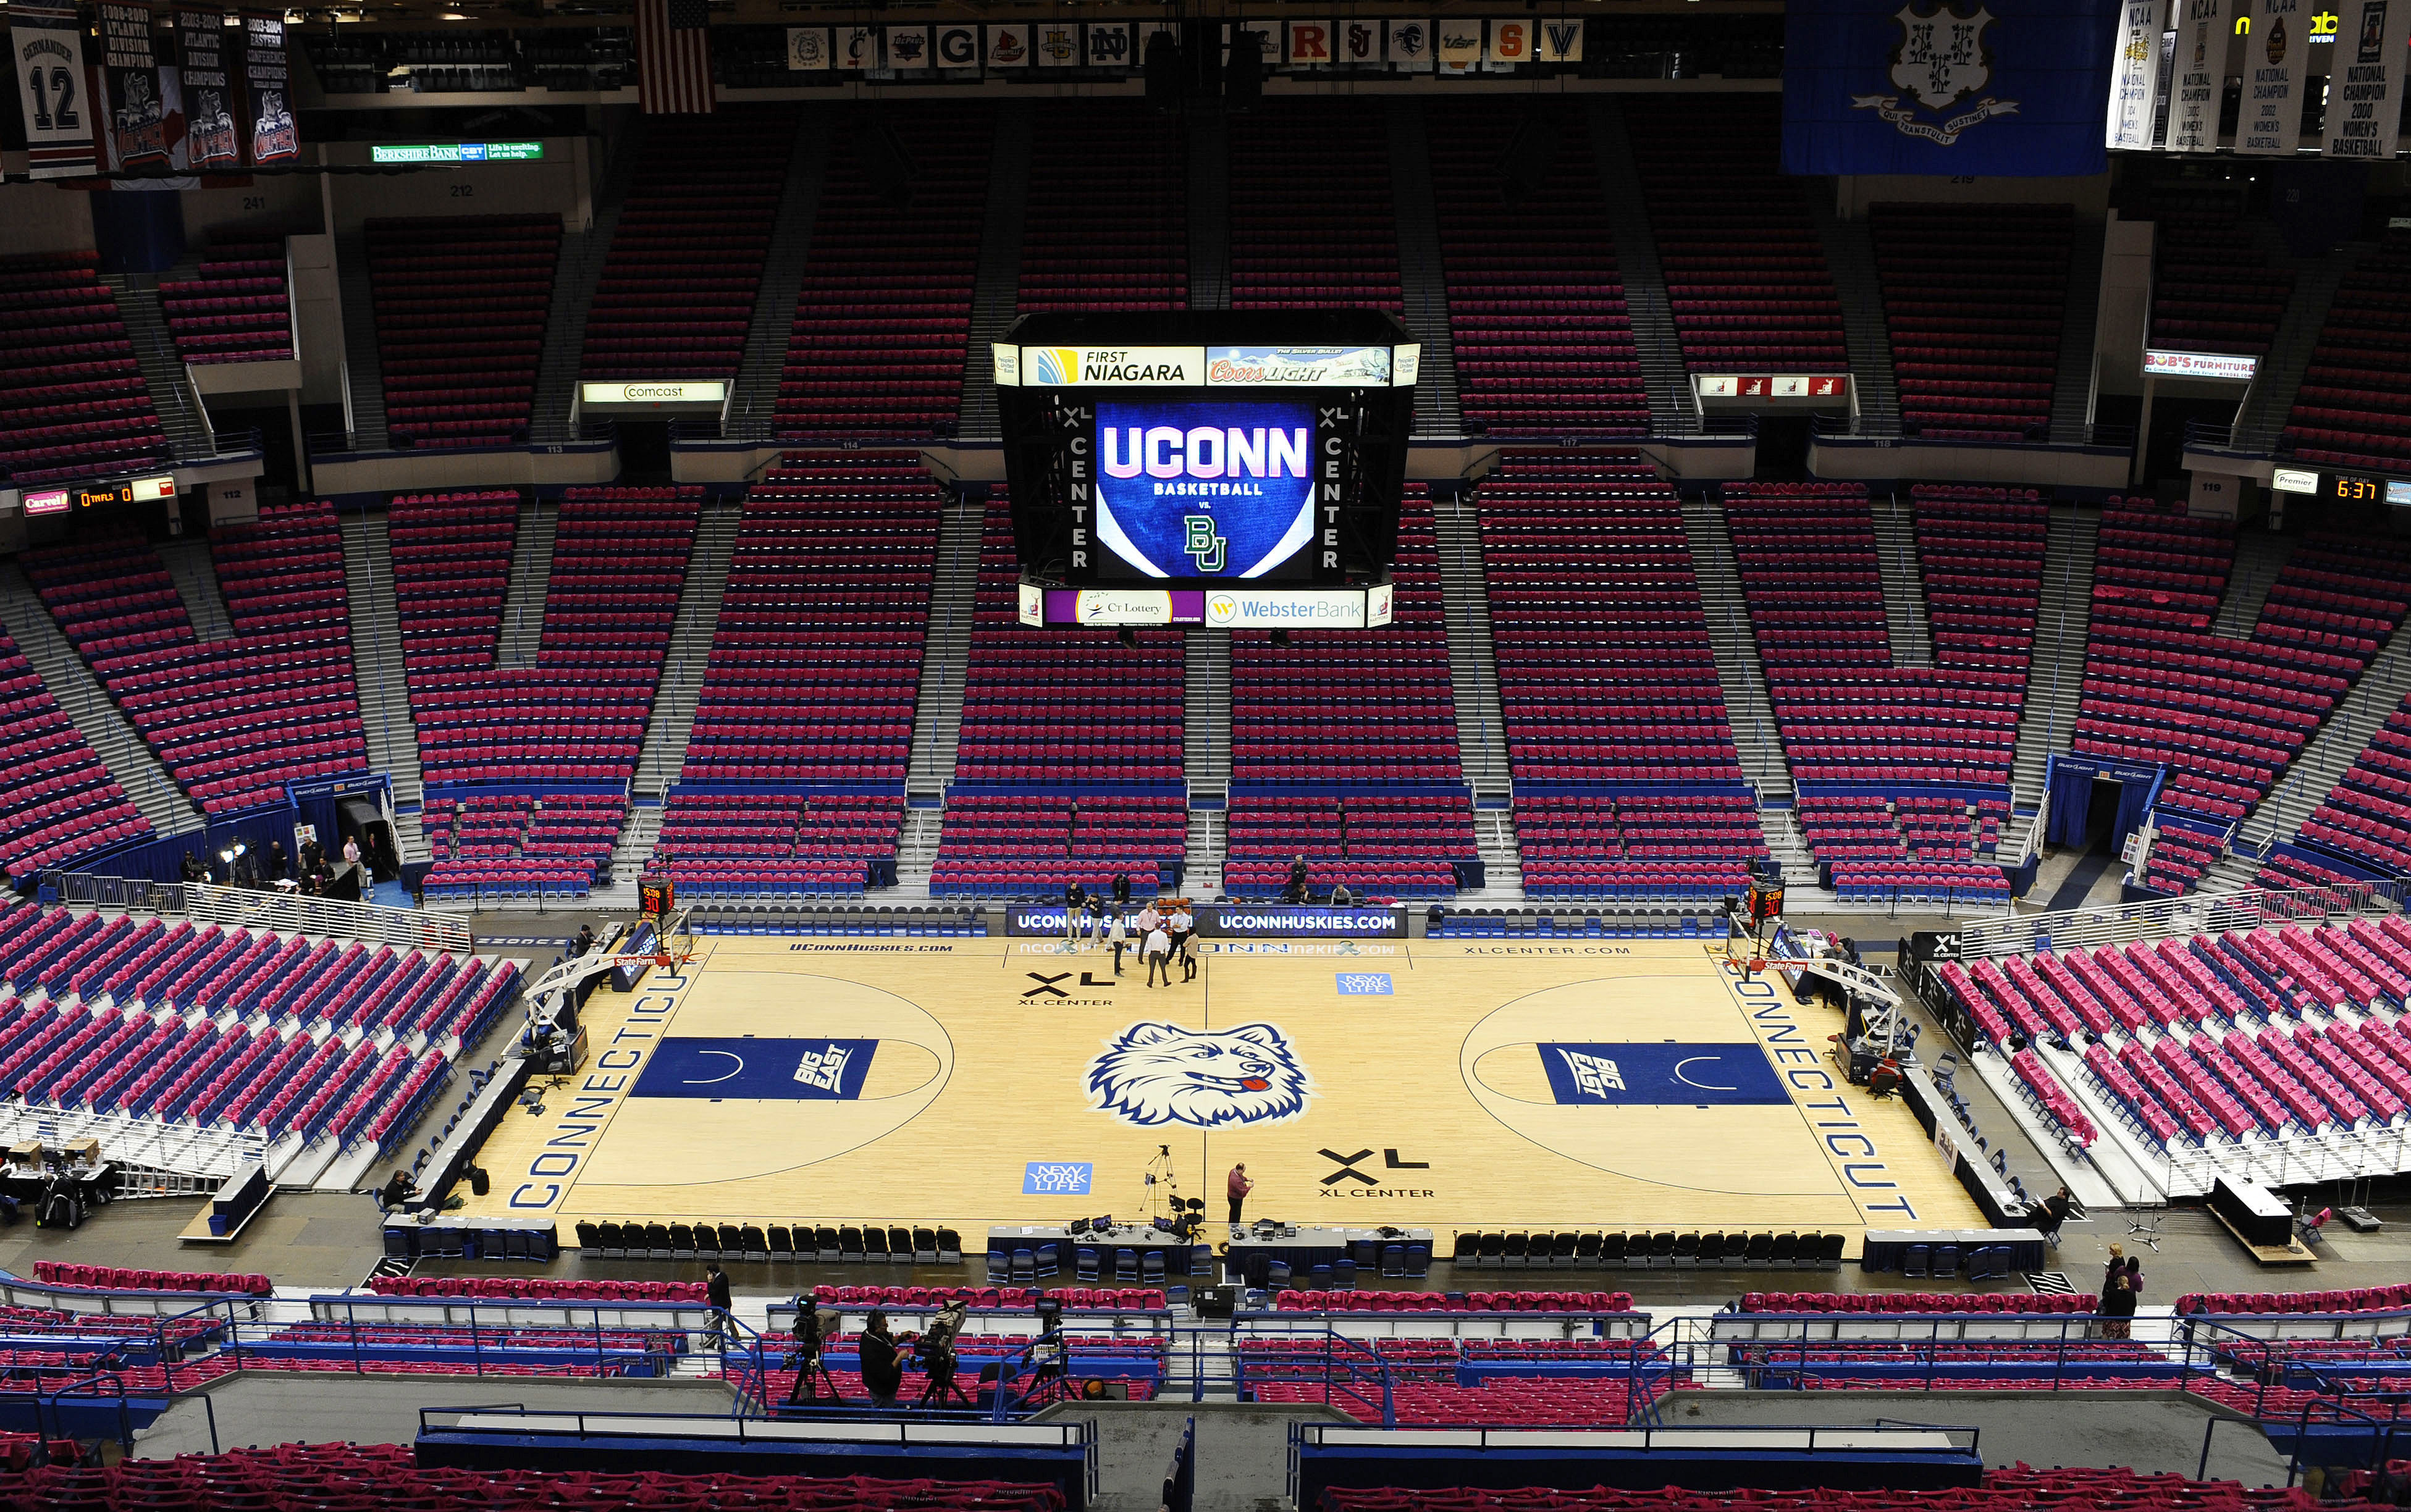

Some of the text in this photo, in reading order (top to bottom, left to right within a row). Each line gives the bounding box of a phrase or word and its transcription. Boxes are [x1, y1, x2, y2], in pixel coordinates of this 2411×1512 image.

[2129, 7, 2152, 27] NCAA
[2190, 0, 2218, 20] NCAA
[247, 17, 282, 33] 2003-2004
[109, 36, 150, 53] DIVISION
[183, 32, 220, 49] ATLANTIC
[250, 33, 281, 48] EASTERN
[941, 30, 974, 63] G
[1292, 26, 1327, 57] R
[1500, 24, 1523, 56] S
[1544, 24, 1578, 56] V
[22, 39, 72, 62] GERNANDER
[246, 49, 286, 64] CONFERENCE
[247, 65, 287, 79] CHAMPIONS
[2182, 73, 2211, 86] NATIONAL
[2255, 68, 2289, 82] NATIONAL
[2347, 66, 2386, 82] NATIONAL
[30, 66, 79, 130] 12
[2120, 88, 2145, 101] CHMPION
[2181, 88, 2210, 102] CHAMPION
[2253, 84, 2289, 99] CHAMPION
[2344, 84, 2386, 101] CHAMPION
[2352, 103, 2373, 119] 2000
[1884, 111, 1987, 144] QUI TRANSTULIT SUSTINET
[2254, 121, 2279, 132] WOMEN'S
[2349, 121, 2378, 136] WOMEN'S
[2247, 136, 2281, 149] BASKETBALL
[2333, 139, 2383, 155] BASKETBALL
[372, 145, 460, 161] BERKSHIRE BANK
[450, 185, 473, 196] 212
[244, 198, 264, 209] 241
[1087, 351, 1127, 363] FIRST
[1085, 364, 1185, 381] NIAGARA
[1210, 360, 1326, 382] Coors LIGHT
[2194, 361, 2255, 372] FURNITURE
[624, 384, 683, 400] comcast
[1064, 407, 1092, 427] XL
[1320, 407, 1349, 427] XL
[1103, 426, 1308, 479] UCONN
[2203, 482, 2221, 492] 119
[2279, 476, 2313, 485] Premier
[81, 493, 90, 506] 0
[122, 488, 131, 502] 0
[223, 490, 242, 498] 112
[1153, 483, 1263, 497] BASKETBALL
[2338, 481, 2376, 499] 6:37
[25, 494, 62, 508] Carvel
[1071, 437, 1087, 568] CENTER
[1323, 437, 1342, 568] CENTER
[1184, 515, 1226, 572] BU
[1125, 602, 1162, 615] Lottery
[645, 896, 660, 912] 30
[1765, 891, 1782, 901] 15:08
[1764, 900, 1779, 917] 30
[1219, 915, 1397, 930] UCONNHUSKIES.COM
[789, 943, 953, 952] UCONNHUSKIES.COM
[1465, 947, 1631, 955] XLCENTER.COM
[1934, 934, 1961, 952] XL
[1021, 972, 1116, 998] XL
[1339, 980, 1389, 988] YORK
[793, 1051, 823, 1085] BIG
[812, 1043, 846, 1091] EAST
[1570, 1051, 1607, 1099] EAST
[1592, 1056, 1626, 1091] BIG
[1038, 1165, 1084, 1175] NEW
[1316, 1148, 1430, 1186] XL
[1028, 1172, 1088, 1183] YORK
[1035, 1181, 1081, 1191] LIFE
[1318, 1189, 1434, 1198] XL CENTER
